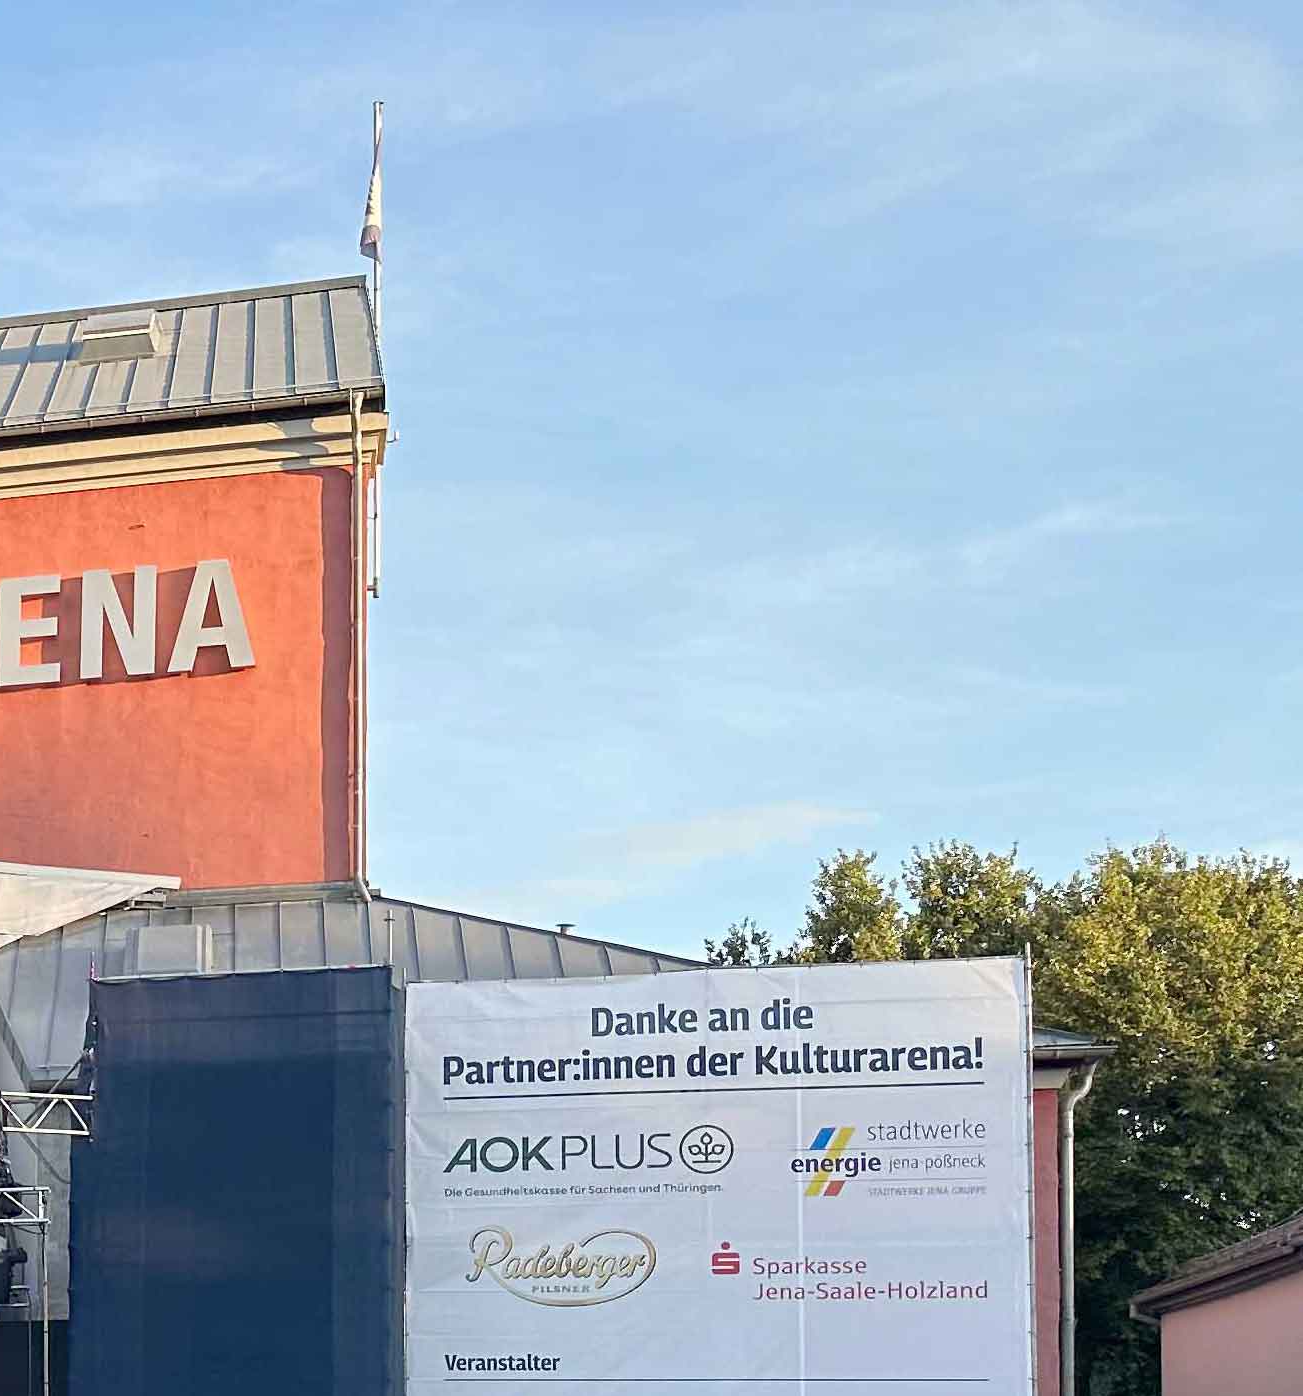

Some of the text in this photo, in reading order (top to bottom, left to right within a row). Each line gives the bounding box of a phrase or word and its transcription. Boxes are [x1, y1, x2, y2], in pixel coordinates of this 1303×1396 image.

[590, 997, 813, 1037] Danke an die
[443, 1036, 983, 1085] Partner:innen der Kulturarena!
[867, 1118, 986, 1142] stadtwerke
[442, 1133, 673, 1173] AOK PLUS
[790, 1152, 881, 1178] energie
[444, 1187, 463, 1198] Die
[464, 1185, 568, 1197] Gesundheitskasse
[588, 1184, 637, 1195] Sachsen
[638, 1183, 660, 1195] und
[465, 1225, 648, 1290] Radeberger
[751, 1256, 868, 1279] Sparkasse
[753, 1280, 988, 1301] Jena-Saale-Holzland
[444, 1353, 561, 1372] Veranstalter
